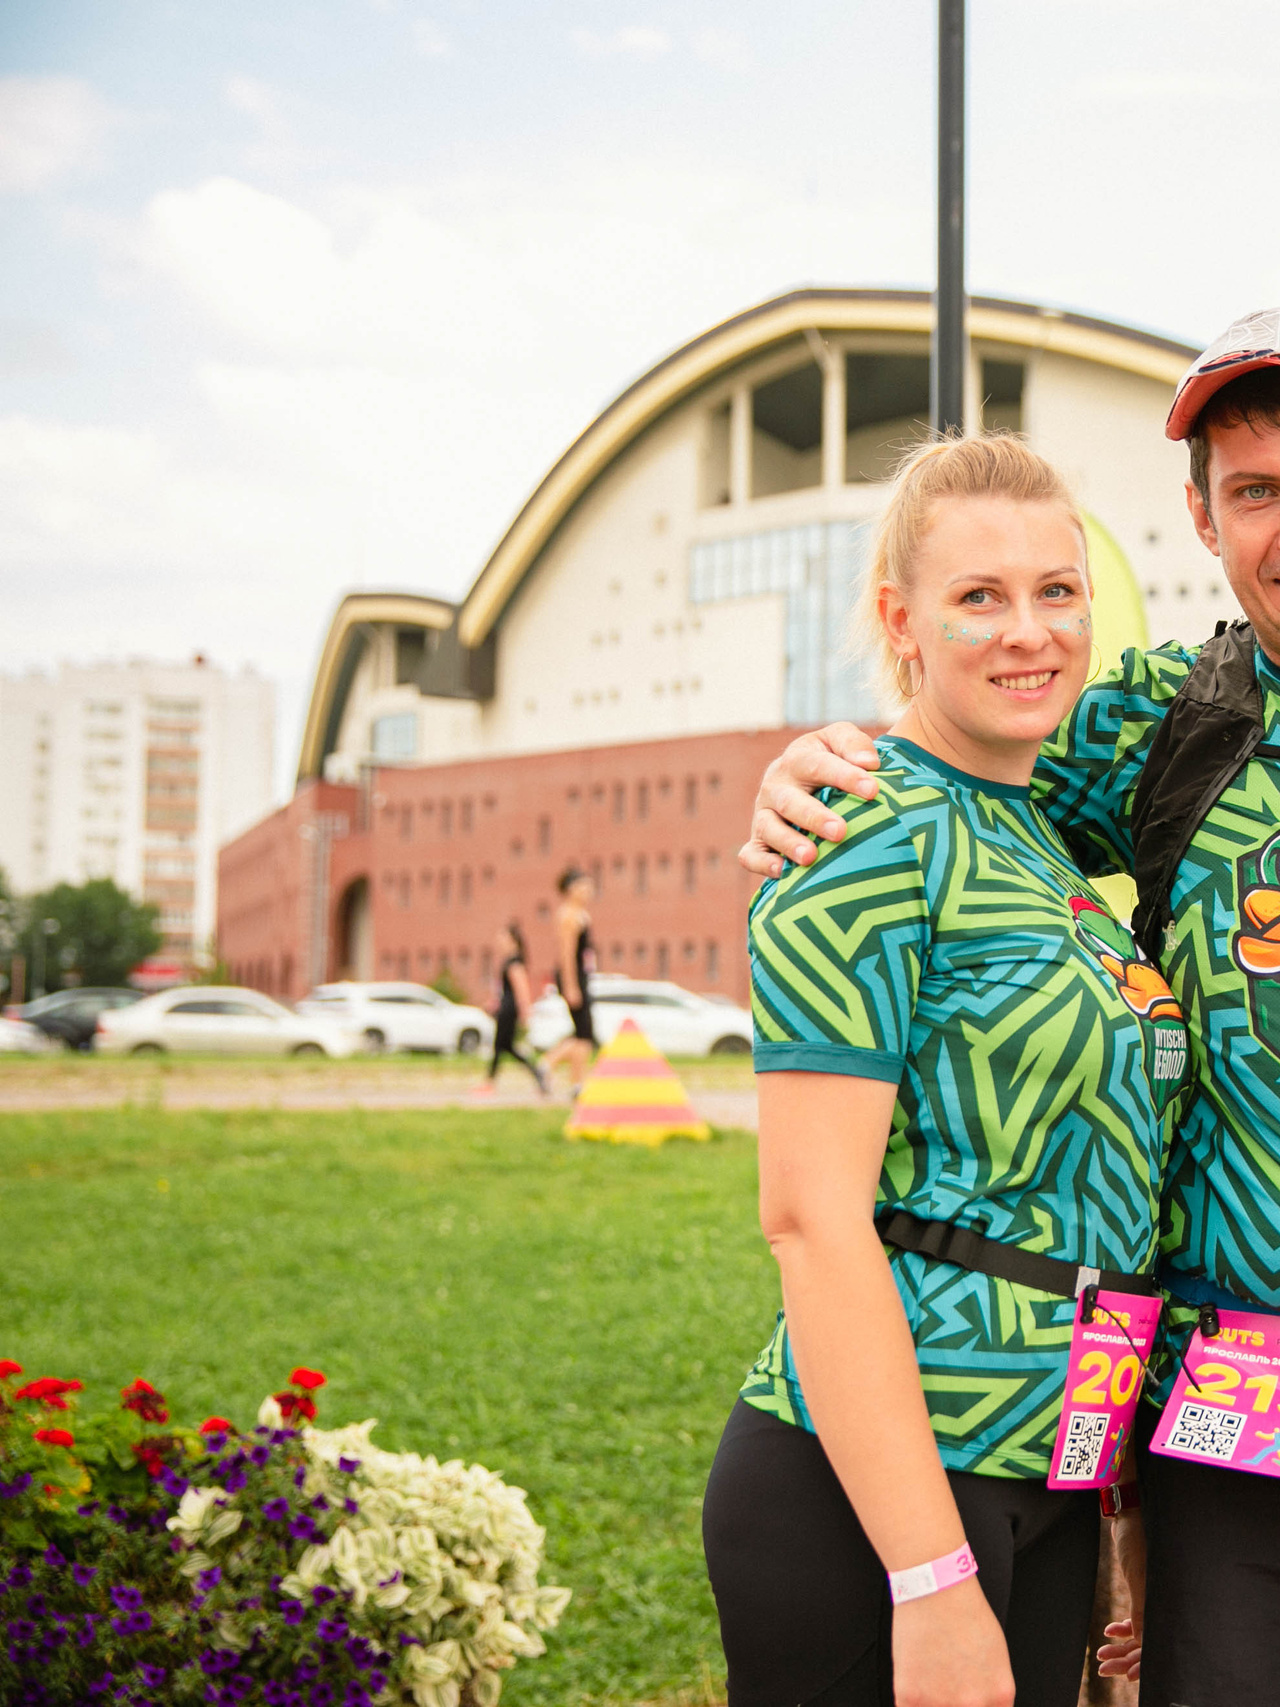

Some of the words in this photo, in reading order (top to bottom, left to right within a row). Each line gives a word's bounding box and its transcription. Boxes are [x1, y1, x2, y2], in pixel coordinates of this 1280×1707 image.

[1154, 1027, 1187, 1049] MYTISCHI
[1153, 1048, 1186, 1080] BEGOOD
[1091, 1307, 1131, 1328] UTS
[1203, 1346, 1271, 1365] ЯРОСЛАВЛЬ
